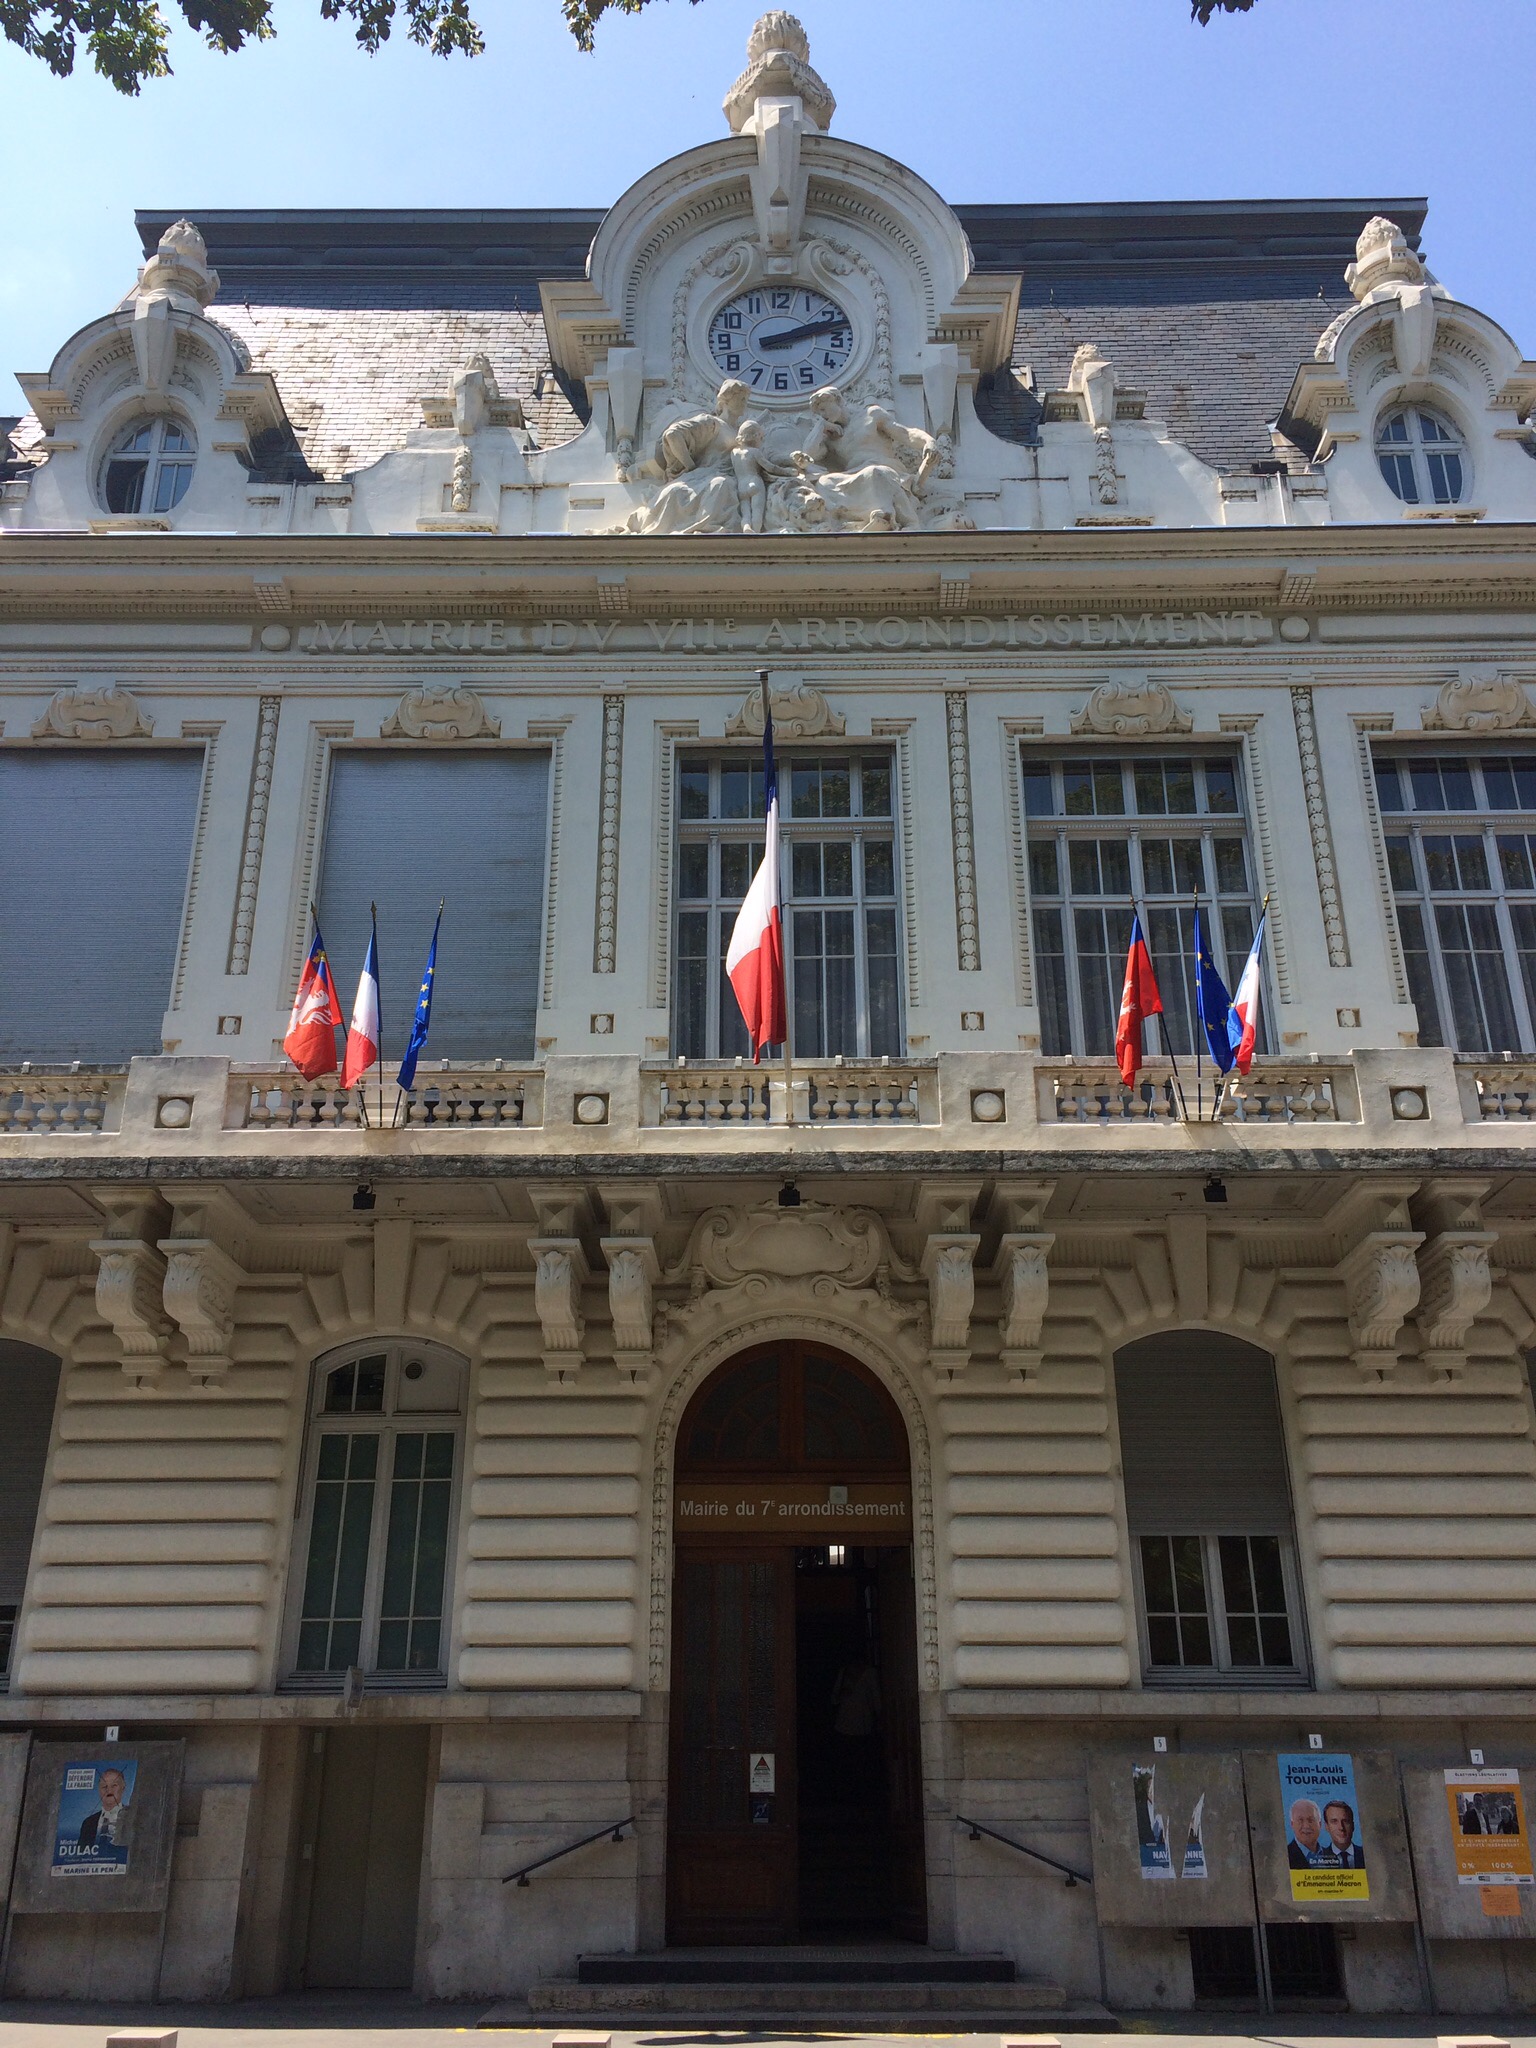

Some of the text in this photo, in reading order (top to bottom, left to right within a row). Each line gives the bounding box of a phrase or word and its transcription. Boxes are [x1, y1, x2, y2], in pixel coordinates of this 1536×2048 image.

[749, 297, 760, 314] 11
[772, 293, 790, 309] 12
[805, 296, 811, 312] 1
[724, 312, 741, 329] 10
[718, 333, 731, 350] 9
[831, 331, 844, 348] 3
[726, 354, 740, 371] 8
[823, 352, 836, 369] 4
[750, 368, 763, 385] 7
[774, 373, 788, 390] 6
[800, 367, 813, 384] 5
[307, 619, 505, 653] MAIRIE
[757, 611, 1263, 653] ARRONDISSEMENT
[680, 1500, 728, 1516] Mairie
[736, 1500, 755, 1516] du
[778, 1501, 906, 1516] arrondissement
[109, 1729, 114, 1738] 4
[1158, 1739, 1163, 1748] 5
[1287, 1764, 1344, 1776] Jean-Louis
[1285, 1775, 1348, 1785] TOURAINE
[58, 1845, 100, 1856] DULAC
[1152, 1850, 1169, 1859] NAV
